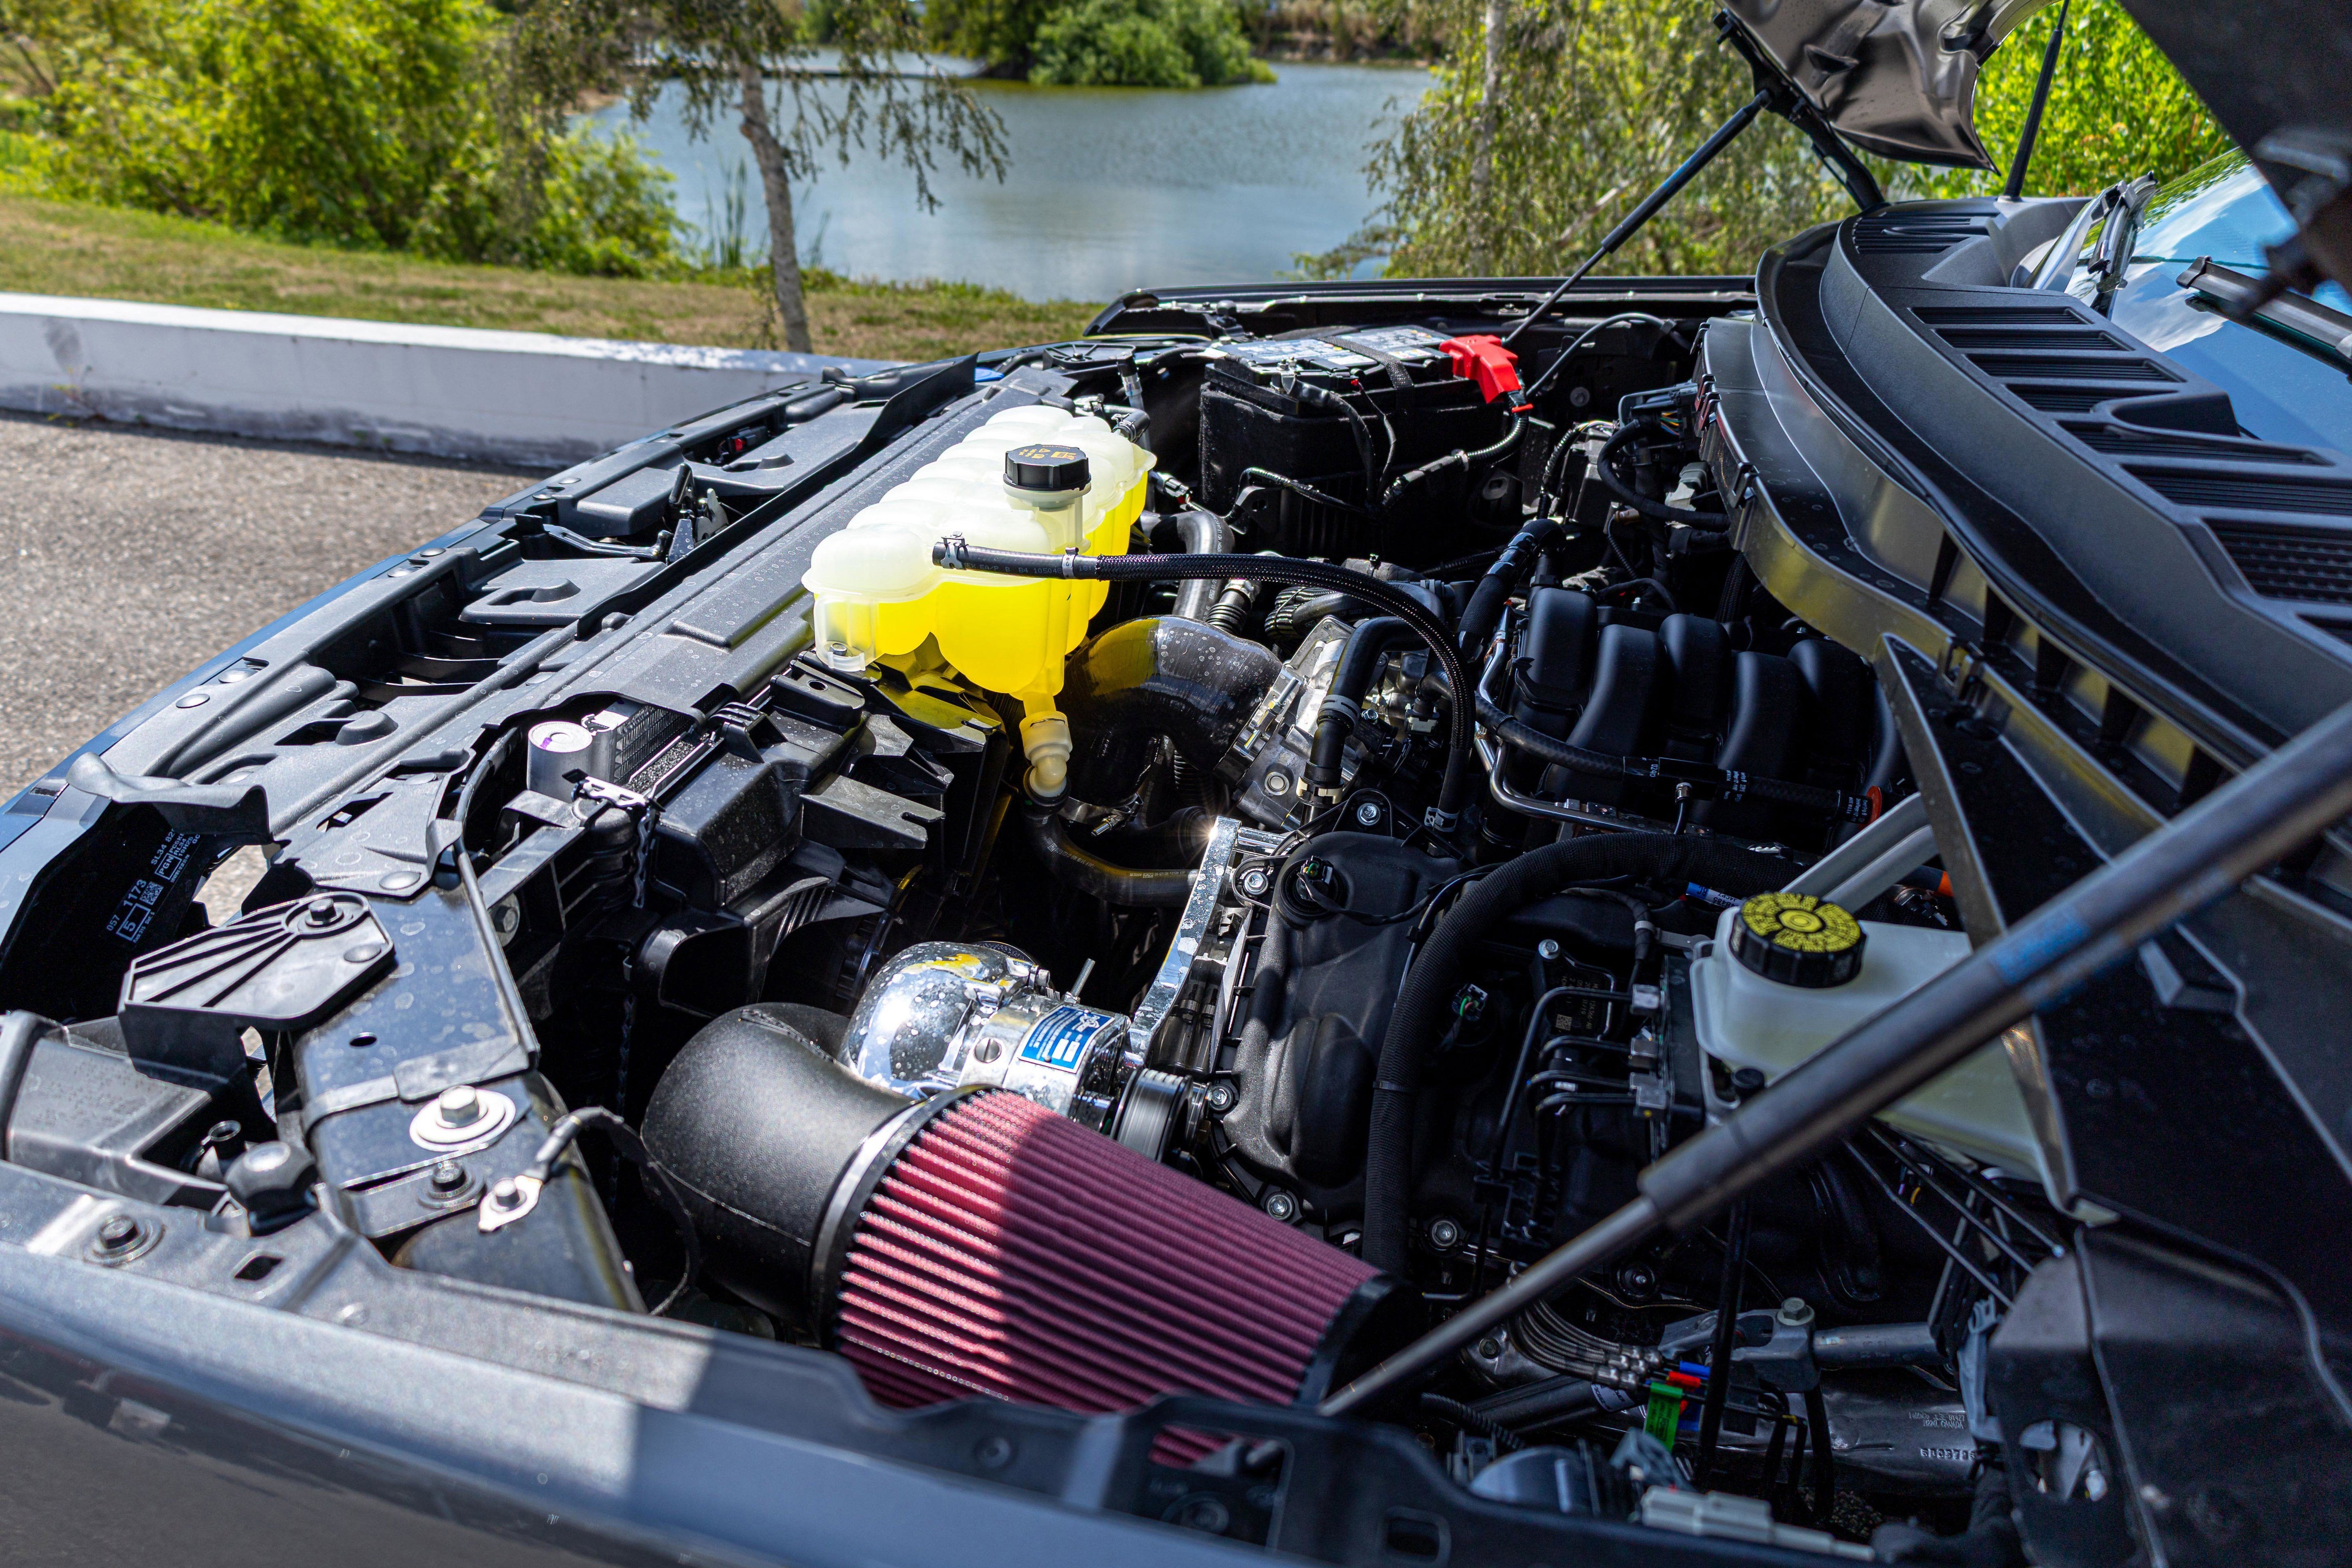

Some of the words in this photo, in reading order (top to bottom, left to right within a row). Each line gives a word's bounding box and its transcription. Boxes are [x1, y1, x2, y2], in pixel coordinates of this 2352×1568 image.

[165, 829, 175, 843] 82
[159, 855, 174, 875] PGN
[123, 879, 147, 906] 1173
[1697, 885, 1708, 897] BC
[106, 914, 120, 931] 057
[123, 920, 136, 932] 5
